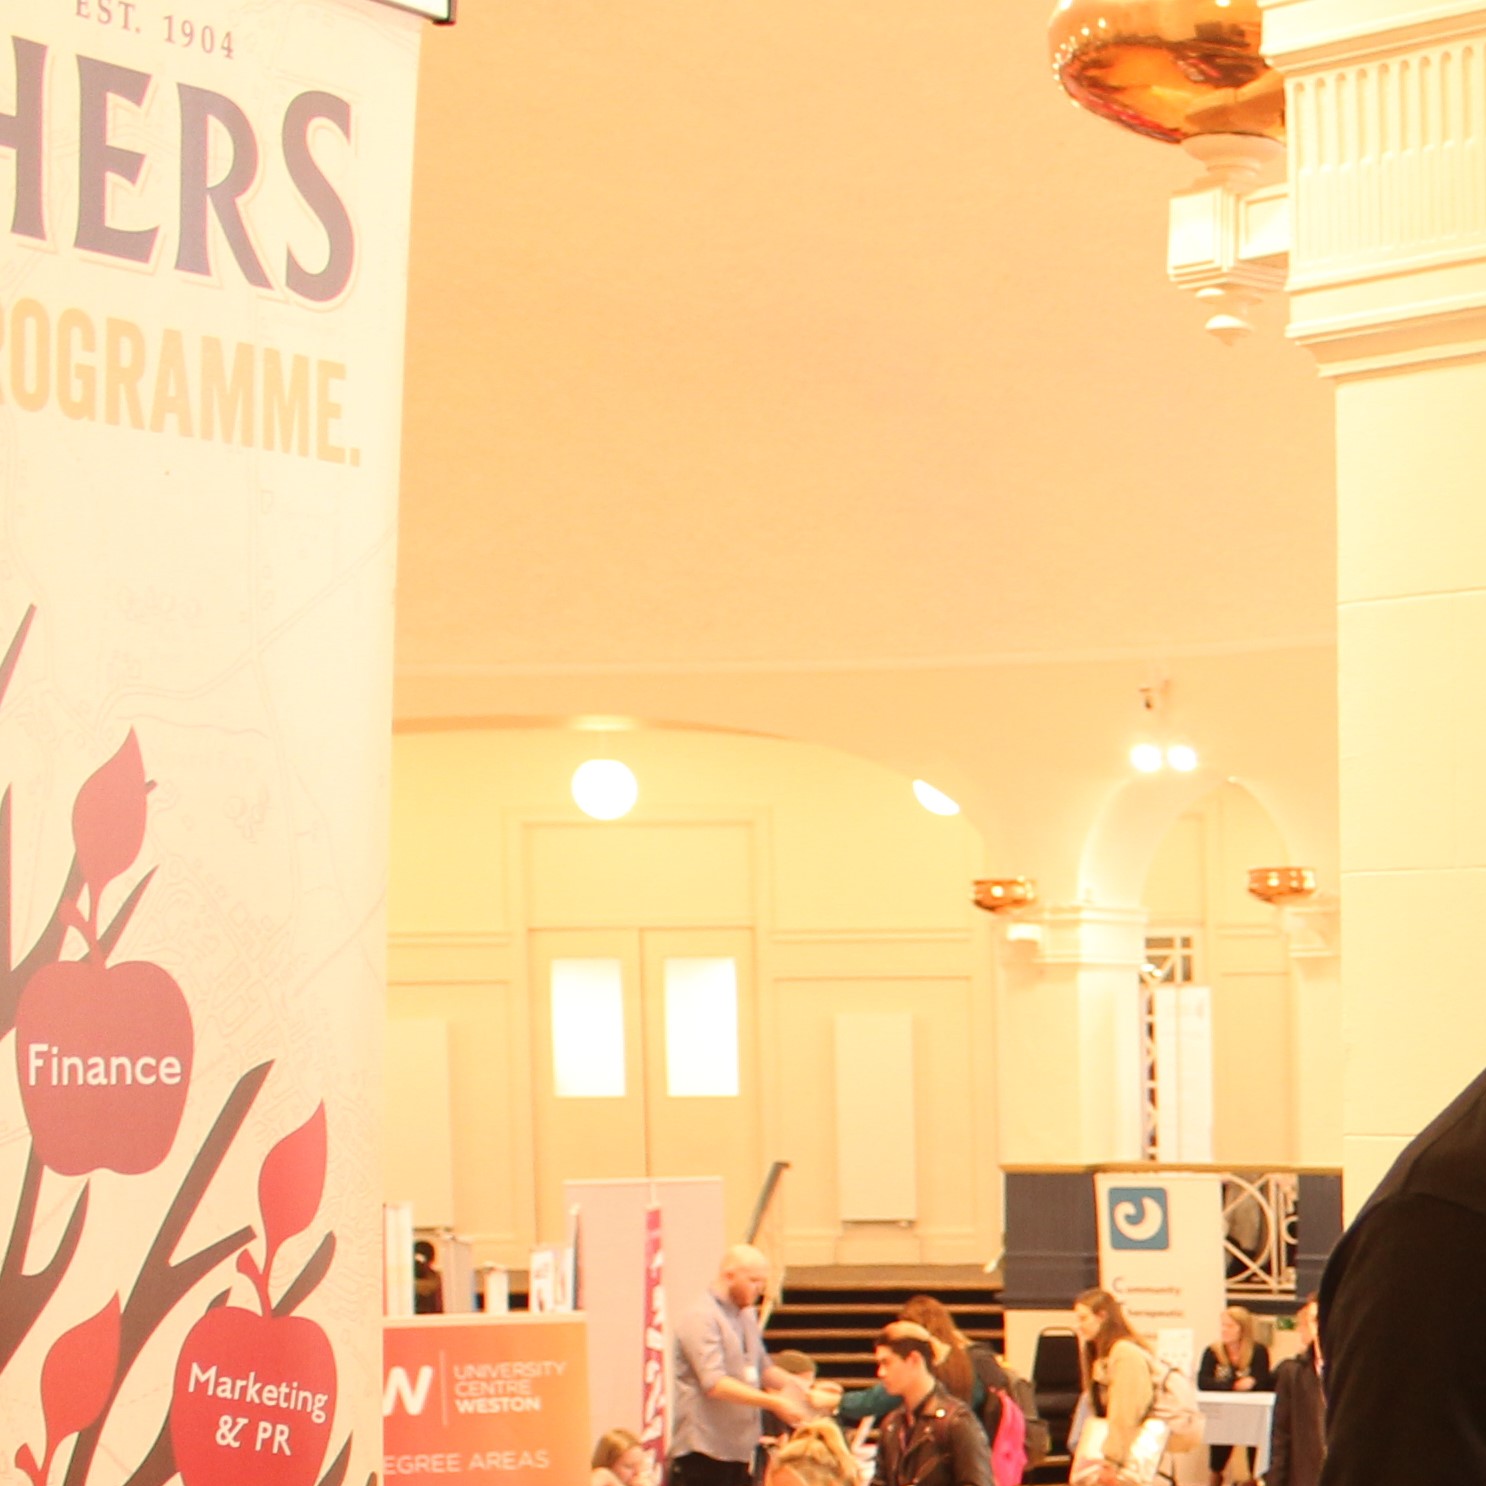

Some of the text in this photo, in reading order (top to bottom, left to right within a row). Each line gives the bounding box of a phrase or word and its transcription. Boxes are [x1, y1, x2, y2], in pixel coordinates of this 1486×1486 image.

[163, 15, 235, 60] 1904
[0, 298, 361, 468] OGRAMME.
[28, 1043, 182, 1086] Finance
[453, 1361, 567, 1379] UNIVERSITY
[455, 1379, 532, 1397] CENTRE
[188, 1362, 328, 1424] Marketing
[455, 1397, 542, 1414] WESTON
[215, 1415, 291, 1456] & PR
[468, 1449, 550, 1471] AREAS
